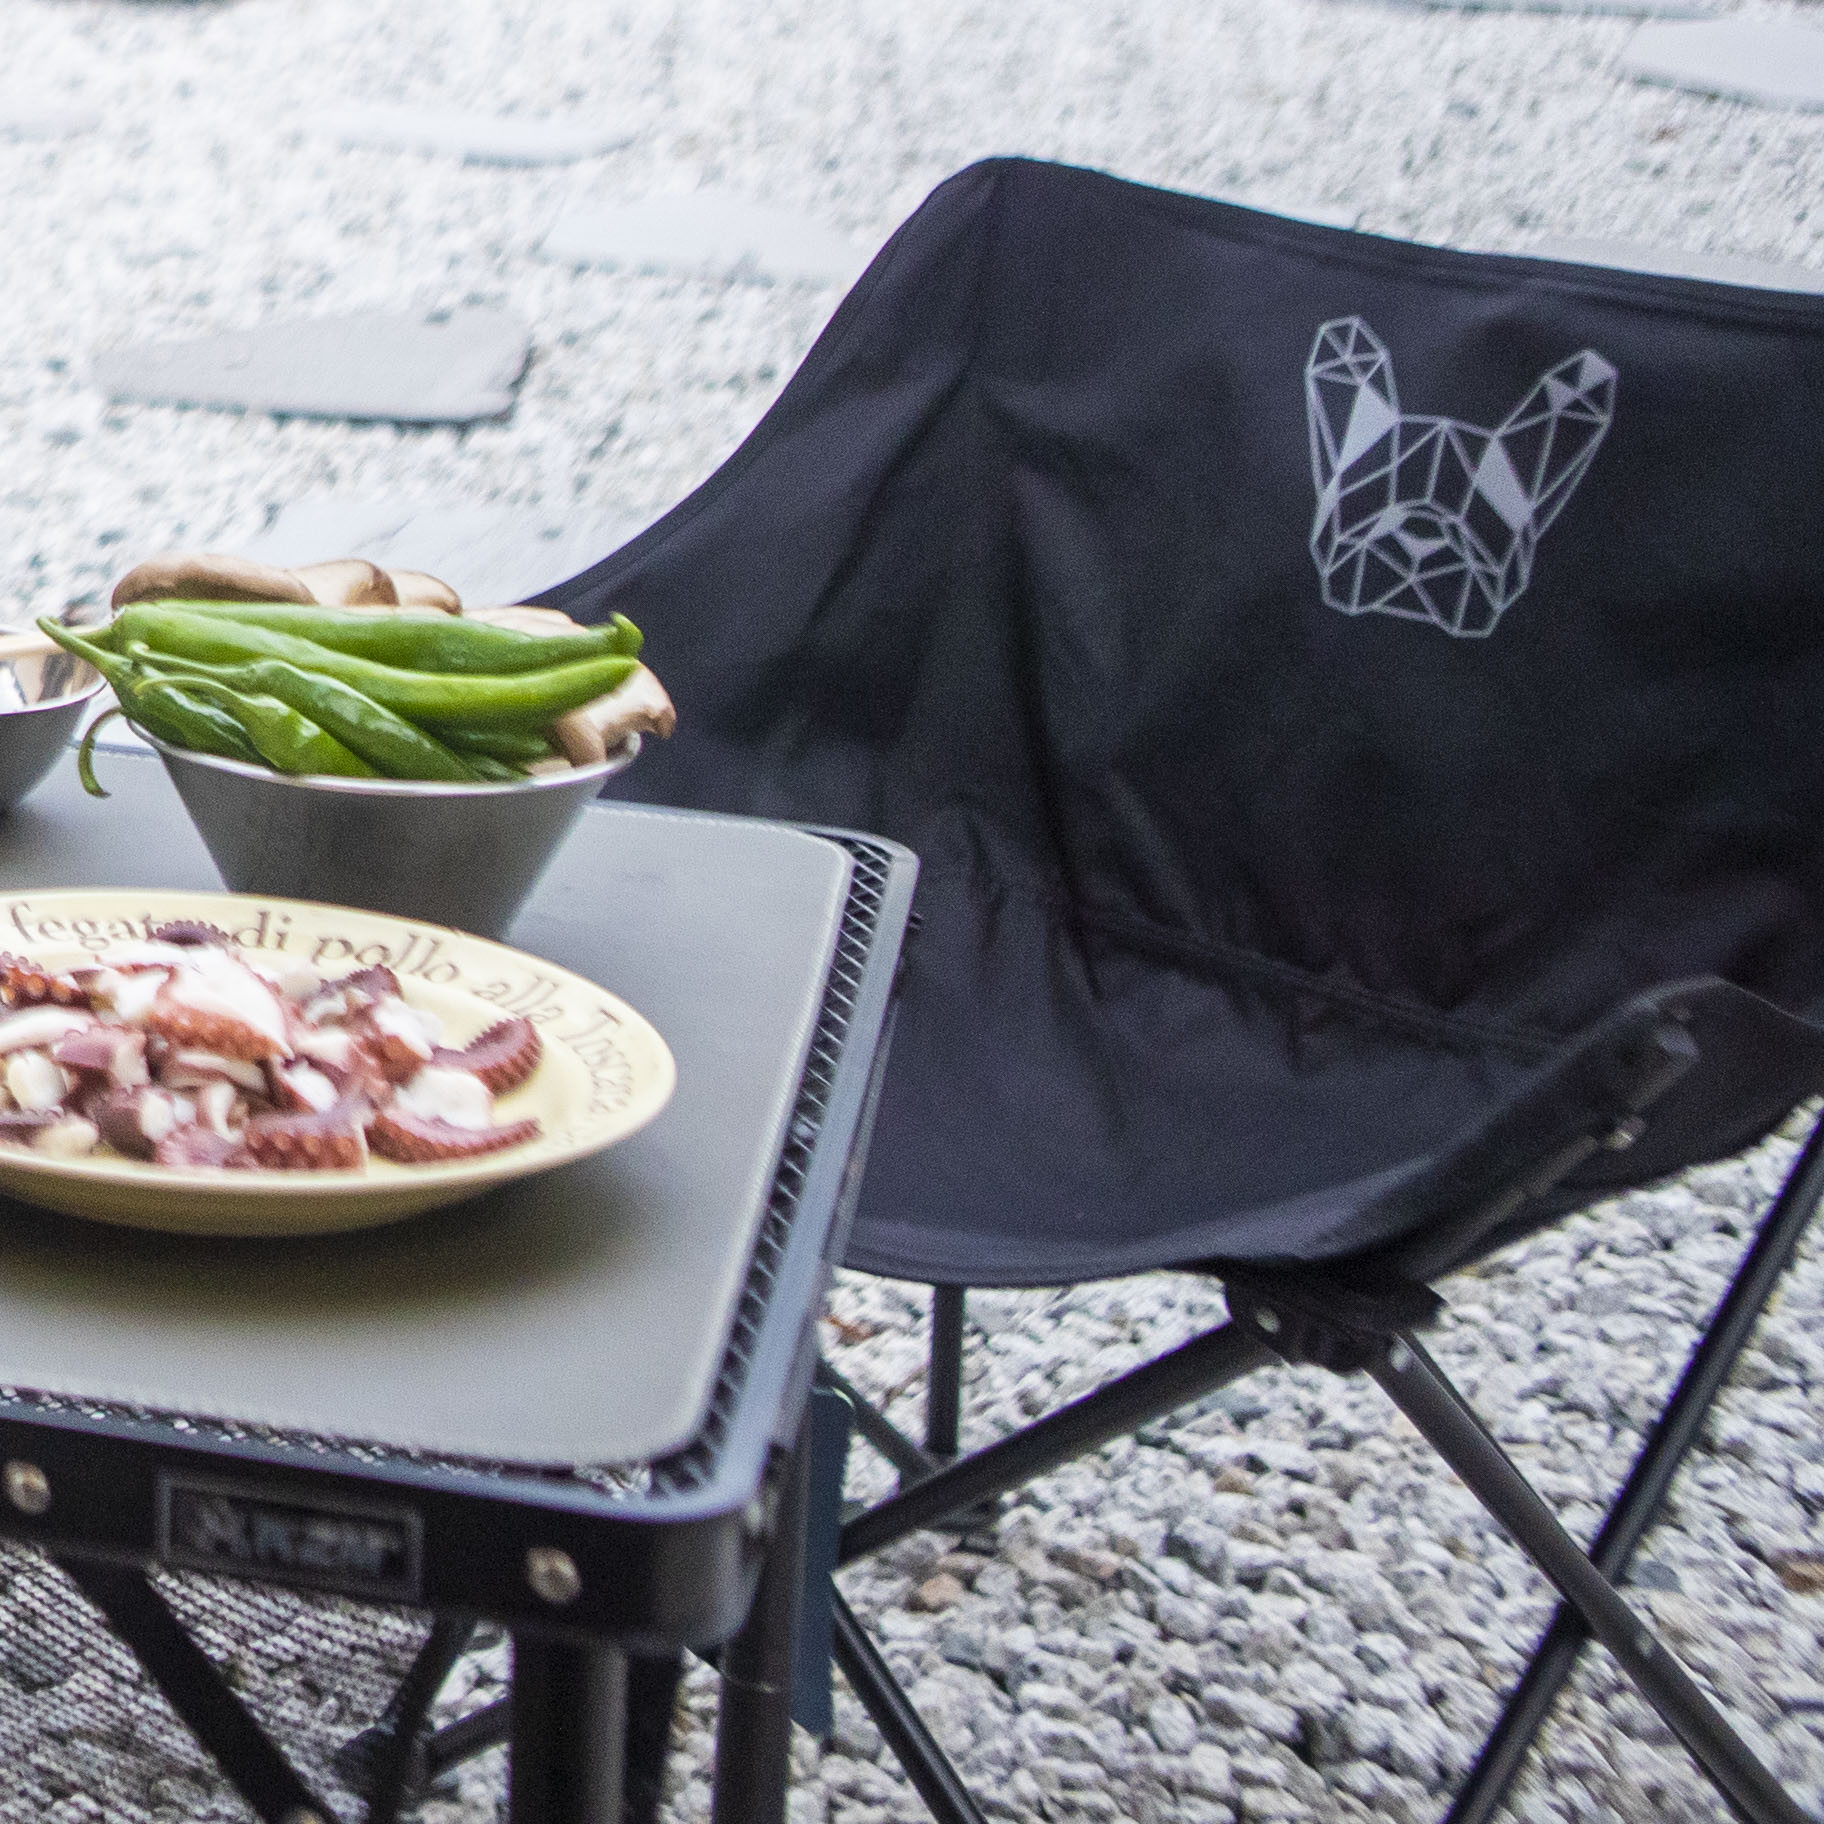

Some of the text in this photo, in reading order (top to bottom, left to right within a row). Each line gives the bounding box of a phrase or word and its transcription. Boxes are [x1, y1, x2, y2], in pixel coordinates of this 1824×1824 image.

[7, 901, 164, 951] fegat
[232, 910, 293, 950] di
[311, 933, 461, 982] pollo
[470, 975, 564, 1023] alla
